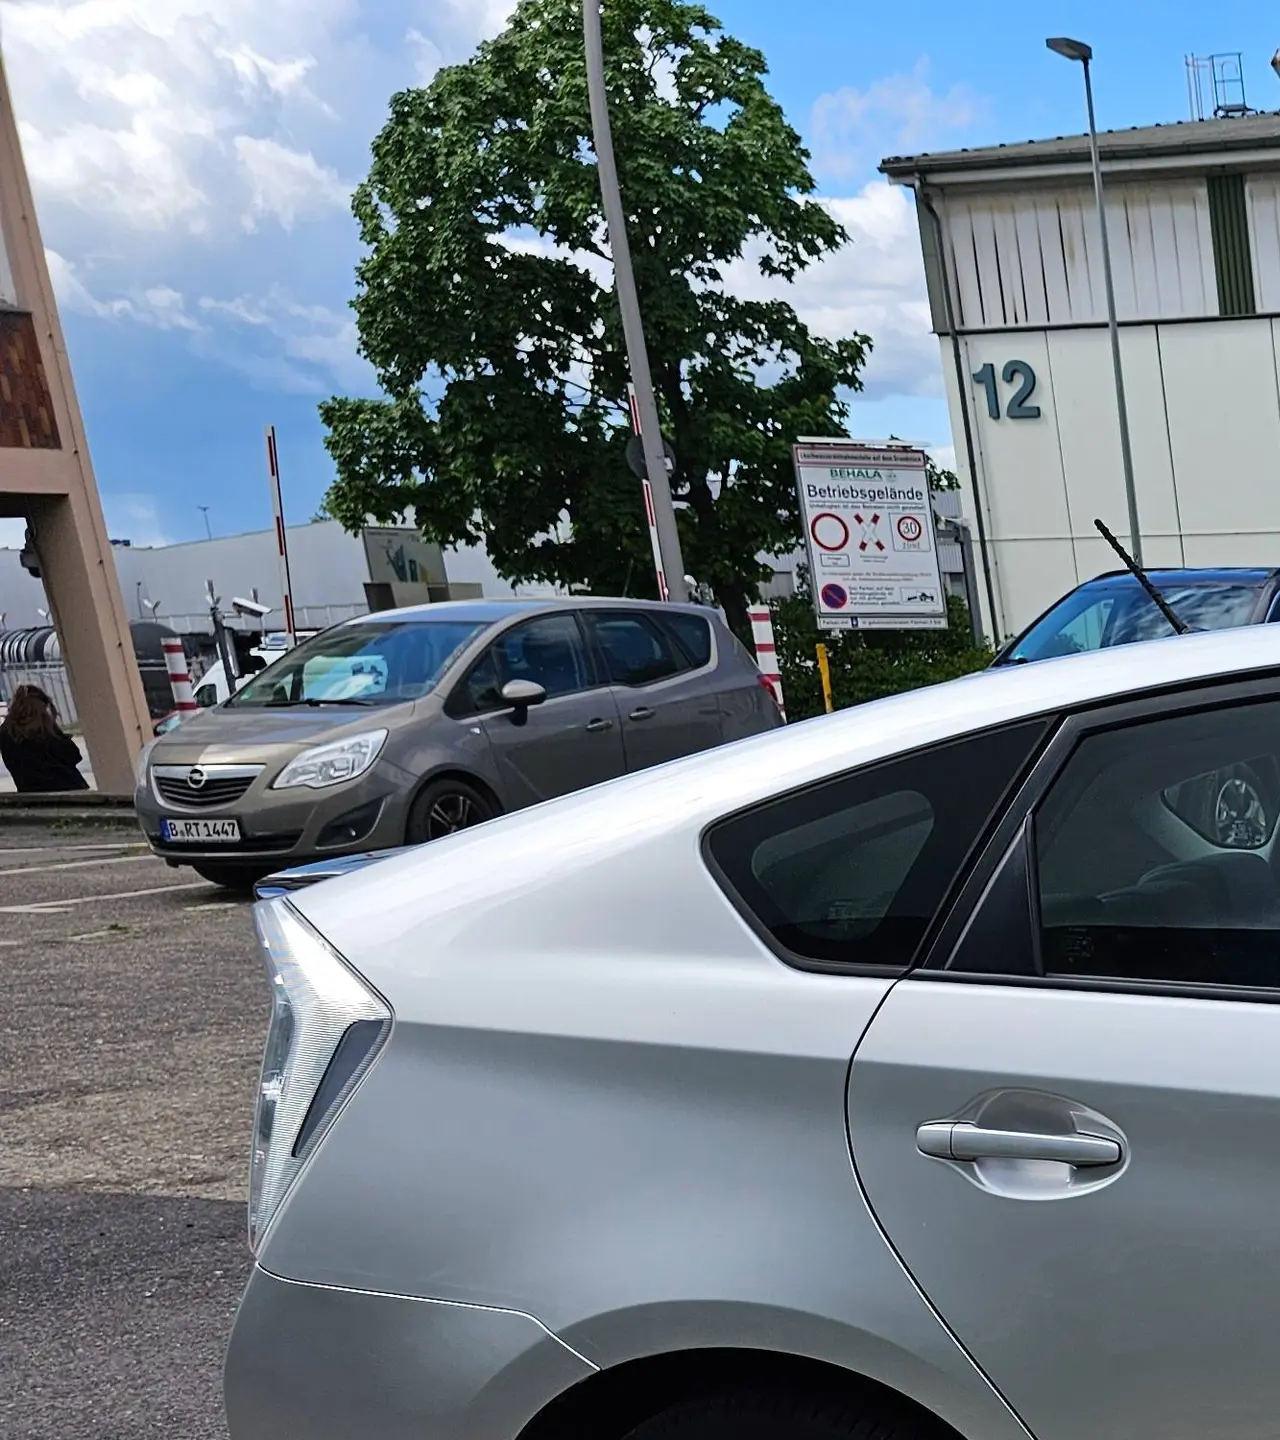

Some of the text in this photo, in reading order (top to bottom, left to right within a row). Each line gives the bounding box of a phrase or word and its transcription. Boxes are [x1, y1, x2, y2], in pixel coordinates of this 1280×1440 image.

[972, 360, 1041, 420] 12
[830, 468, 883, 480] BEHALA
[807, 484, 923, 502] Betriebsgelände
[902, 521, 917, 535] 30
[168, 822, 235, 838] B RT 1447
